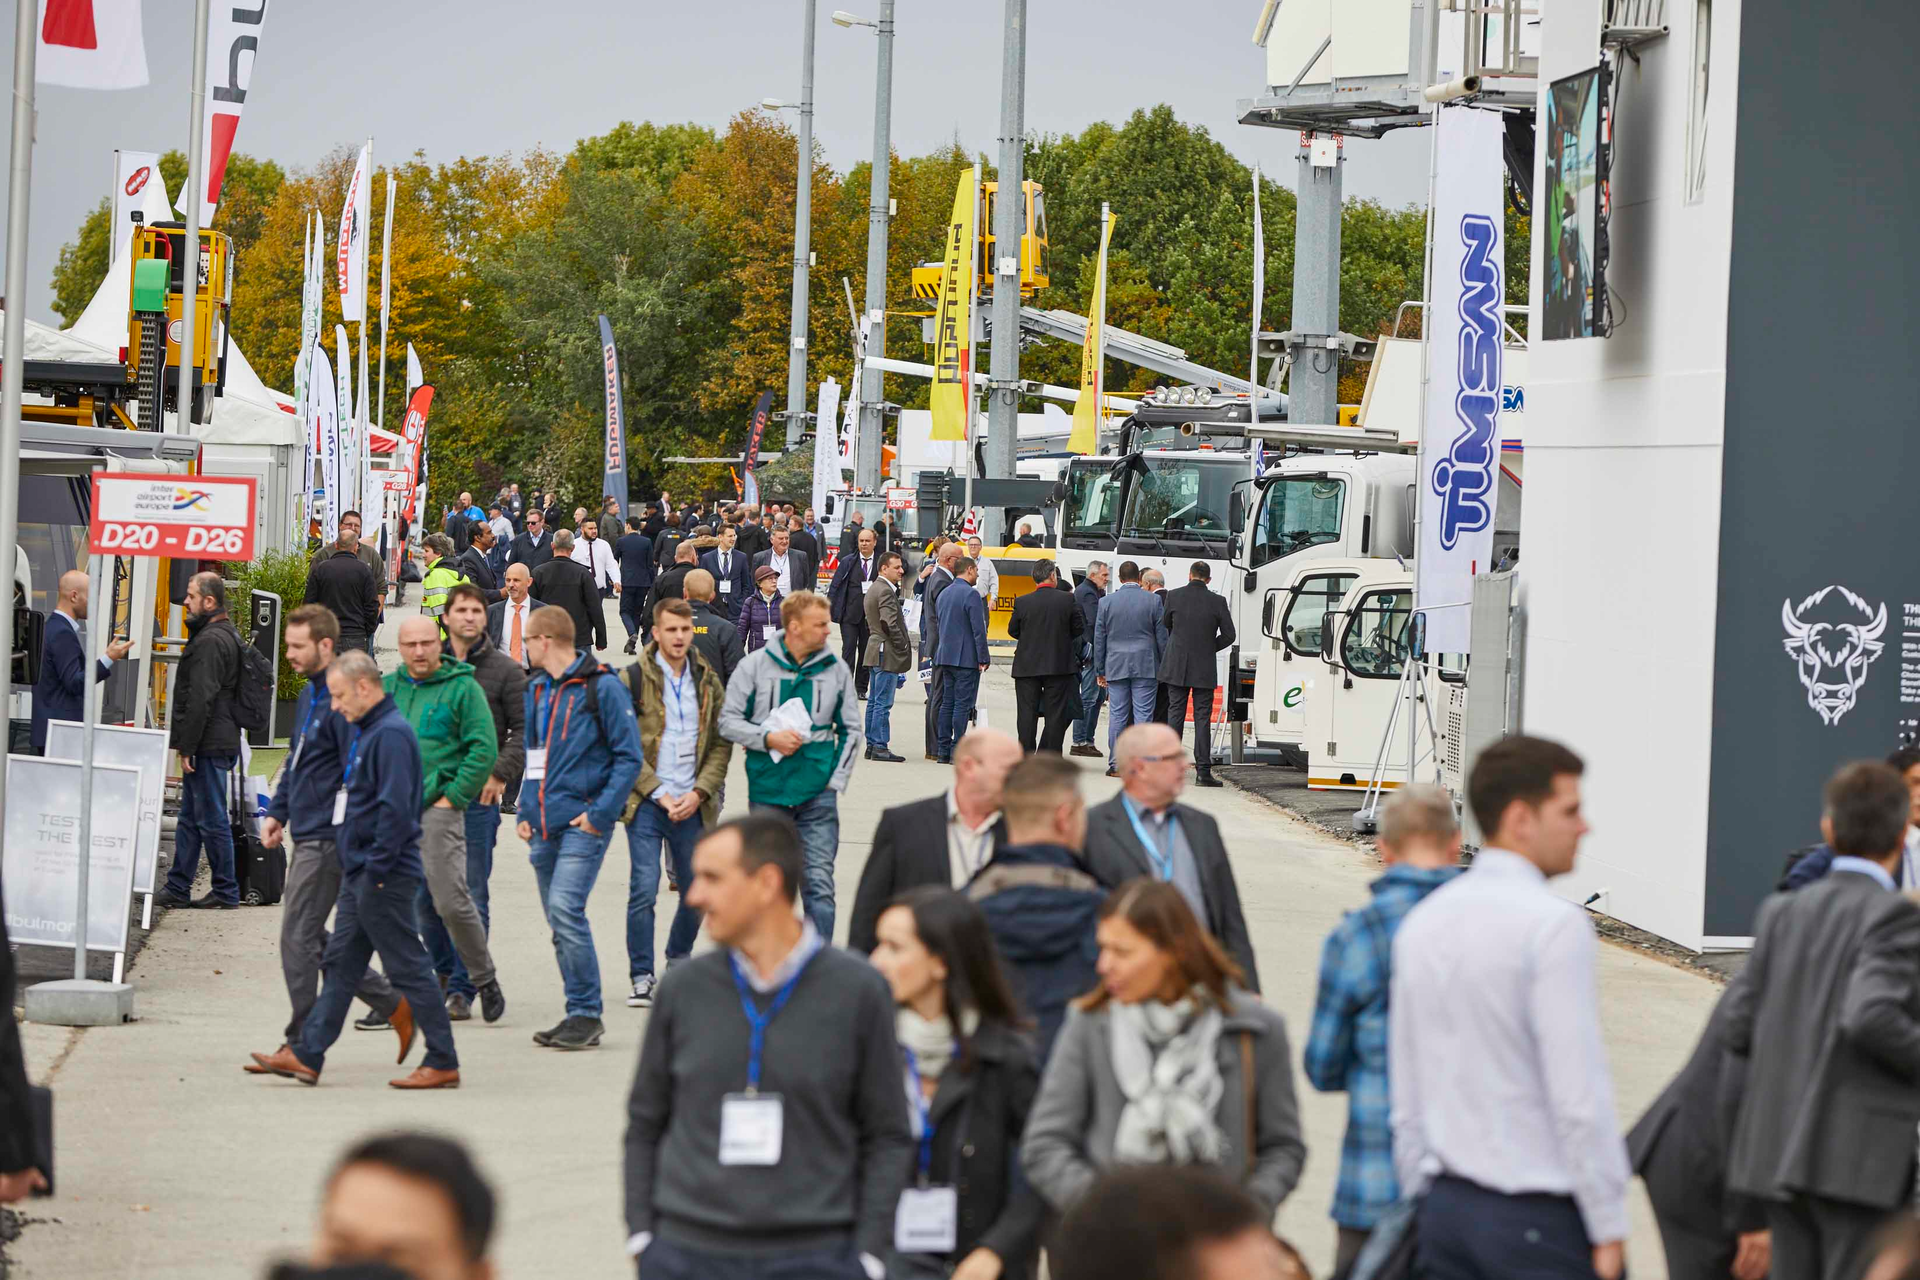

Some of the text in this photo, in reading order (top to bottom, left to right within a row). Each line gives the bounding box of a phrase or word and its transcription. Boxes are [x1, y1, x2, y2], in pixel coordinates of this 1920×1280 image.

[136, 491, 173, 503] airport
[134, 501, 170, 511] europe
[100, 523, 160, 550] D20
[185, 527, 244, 554] D26
[37, 830, 129, 849] THE EST
